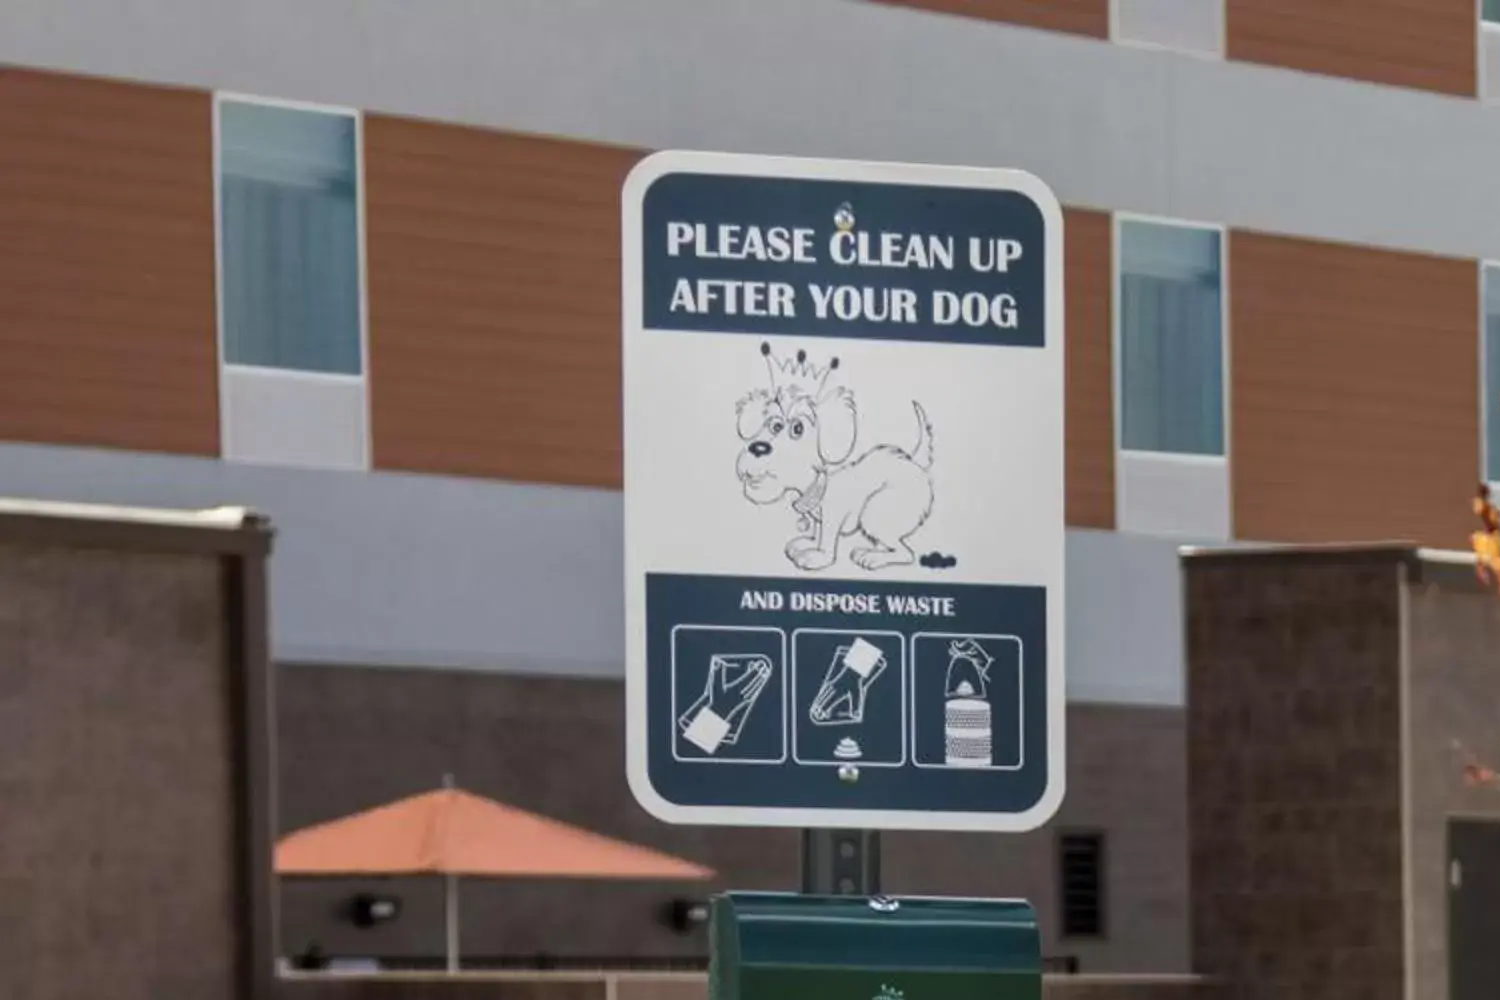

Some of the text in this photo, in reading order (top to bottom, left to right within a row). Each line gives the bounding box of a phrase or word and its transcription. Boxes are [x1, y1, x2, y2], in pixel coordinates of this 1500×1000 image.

[667, 221, 1023, 273] PLEASE CLEAN UP
[669, 278, 1018, 329] AFTER YOUR DOG
[740, 590, 956, 616] AND DISPOSE WASTE
